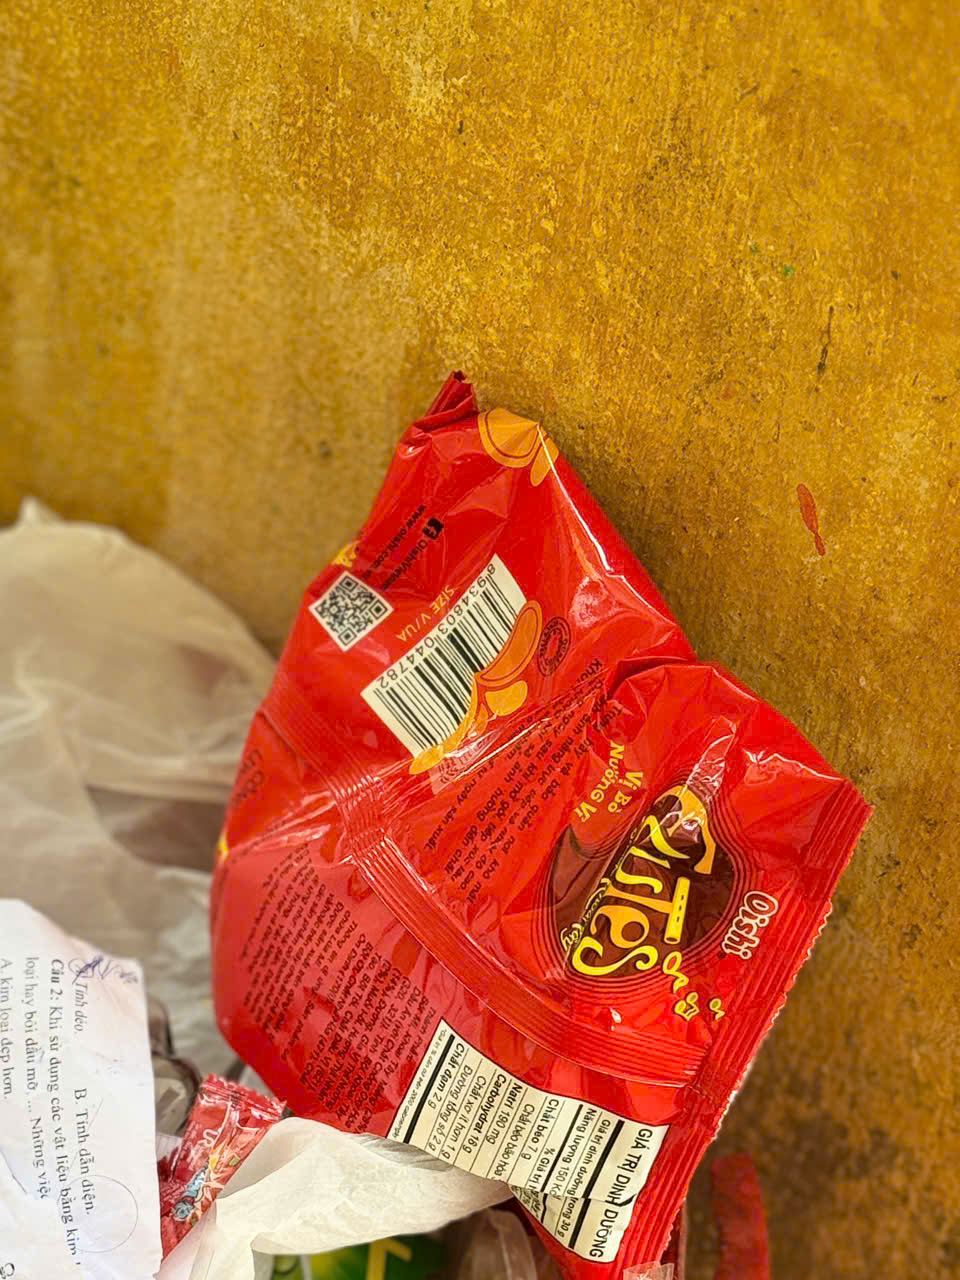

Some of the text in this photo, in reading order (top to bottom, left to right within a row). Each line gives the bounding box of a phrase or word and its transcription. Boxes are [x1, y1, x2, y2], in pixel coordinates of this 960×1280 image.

[394, 583, 457, 643] SIZE V/UA
[435, 574, 488, 634] 934803
[374, 635, 437, 689] 044782
[608, 772, 643, 813] Vị Bò
[574, 801, 598, 823] Vỉ
[721, 890, 778, 960] Oishi
[0, 959, 11, 973] A.
[0, 977, 13, 1002] kim
[74, 982, 88, 1007] Tính
[21, 957, 44, 1168] loại hay dầu Những
[437, 1043, 469, 1092] Chất đạm
[3, 1067, 14, 1099] hơn.
[47, 959, 76, 1224] Câu 2: Khi sử dụng các vật liệu bằng
[436, 1063, 473, 1122] Đường tổng
[464, 1074, 486, 1100] Chất
[76, 1109, 89, 1143] Tính
[462, 1072, 506, 1153] Carbohydrat g
[486, 1084, 522, 1144] Natri 190 mg
[517, 1104, 535, 1124] Chất
[536, 1099, 559, 1122] Chất
[598, 1120, 611, 1134] Giá
[531, 1125, 548, 1143] béo
[556, 1108, 597, 1181] Năng lượng 150
[591, 1135, 603, 1145] trị
[583, 1146, 597, 1164] dinh
[567, 1166, 587, 1195] dưỡng
[589, 1129, 652, 1257] GIÁ TRỊ DINH DƯỠNG
[561, 1220, 570, 1231] 30
